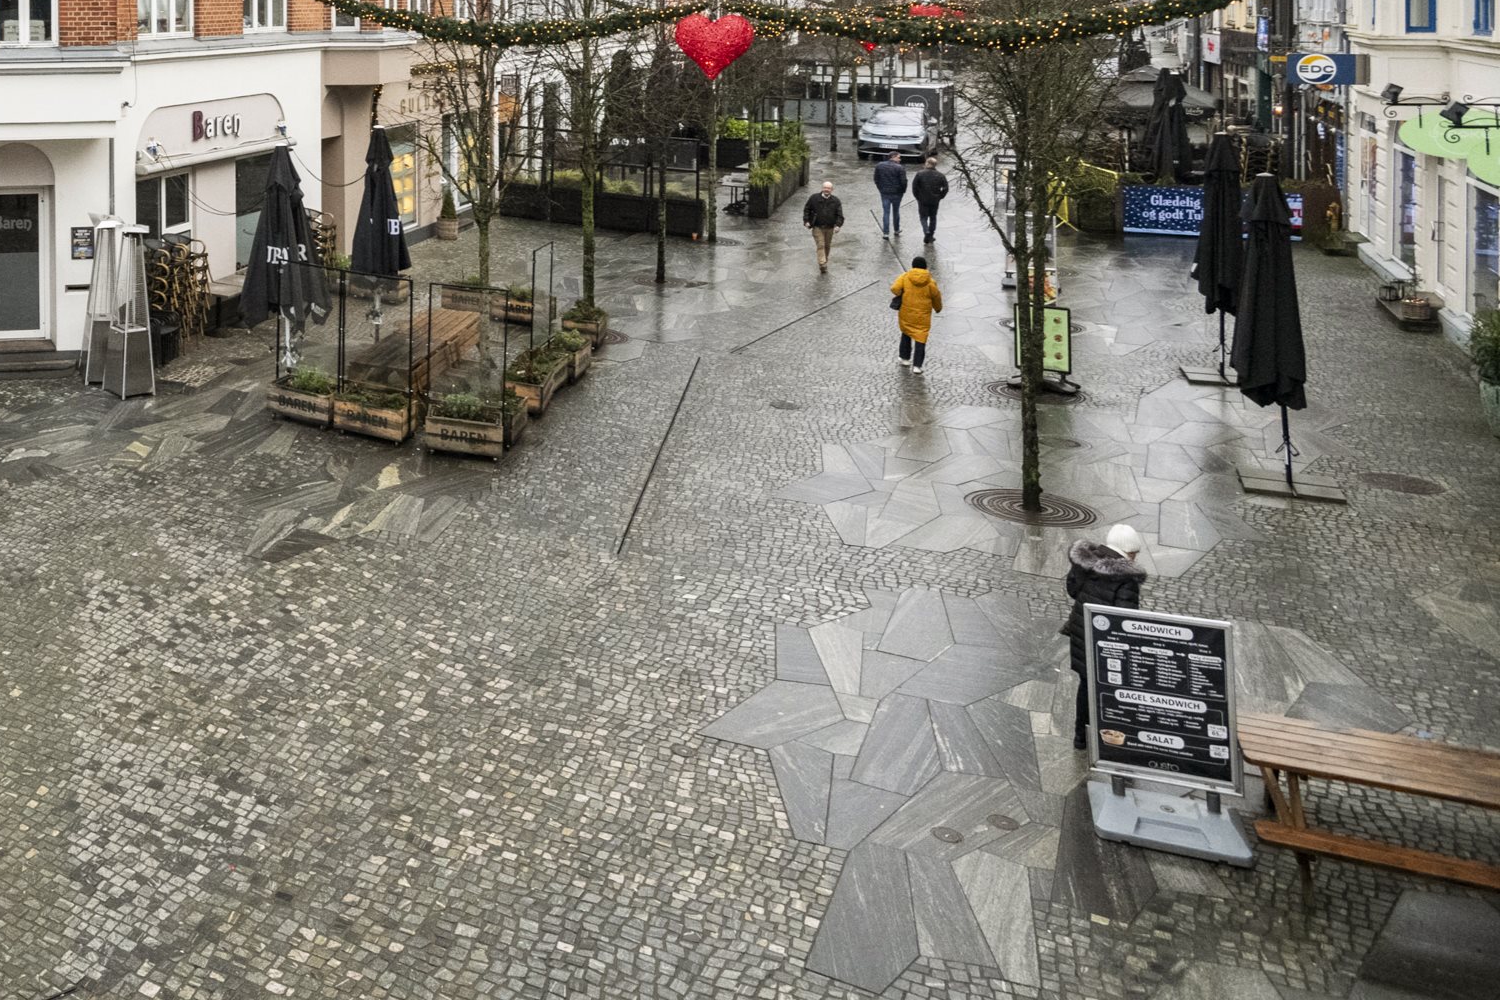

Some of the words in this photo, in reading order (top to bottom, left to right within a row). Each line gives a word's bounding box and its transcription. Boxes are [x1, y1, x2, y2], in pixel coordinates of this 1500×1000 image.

[1299, 65, 1334, 73] EDC
[192, 110, 240, 142] Baren
[1150, 194, 1201, 210] Glædelig
[1142, 211, 1157, 221] og
[1158, 209, 1185, 221] godt
[278, 394, 316, 414] BAREN
[440, 428, 488, 443] BAREN
[1131, 623, 1182, 637] SANDWICH
[1118, 691, 1147, 702] BAGEL
[1149, 696, 1201, 710] SANDWICH
[1146, 734, 1174, 745] SALAT
